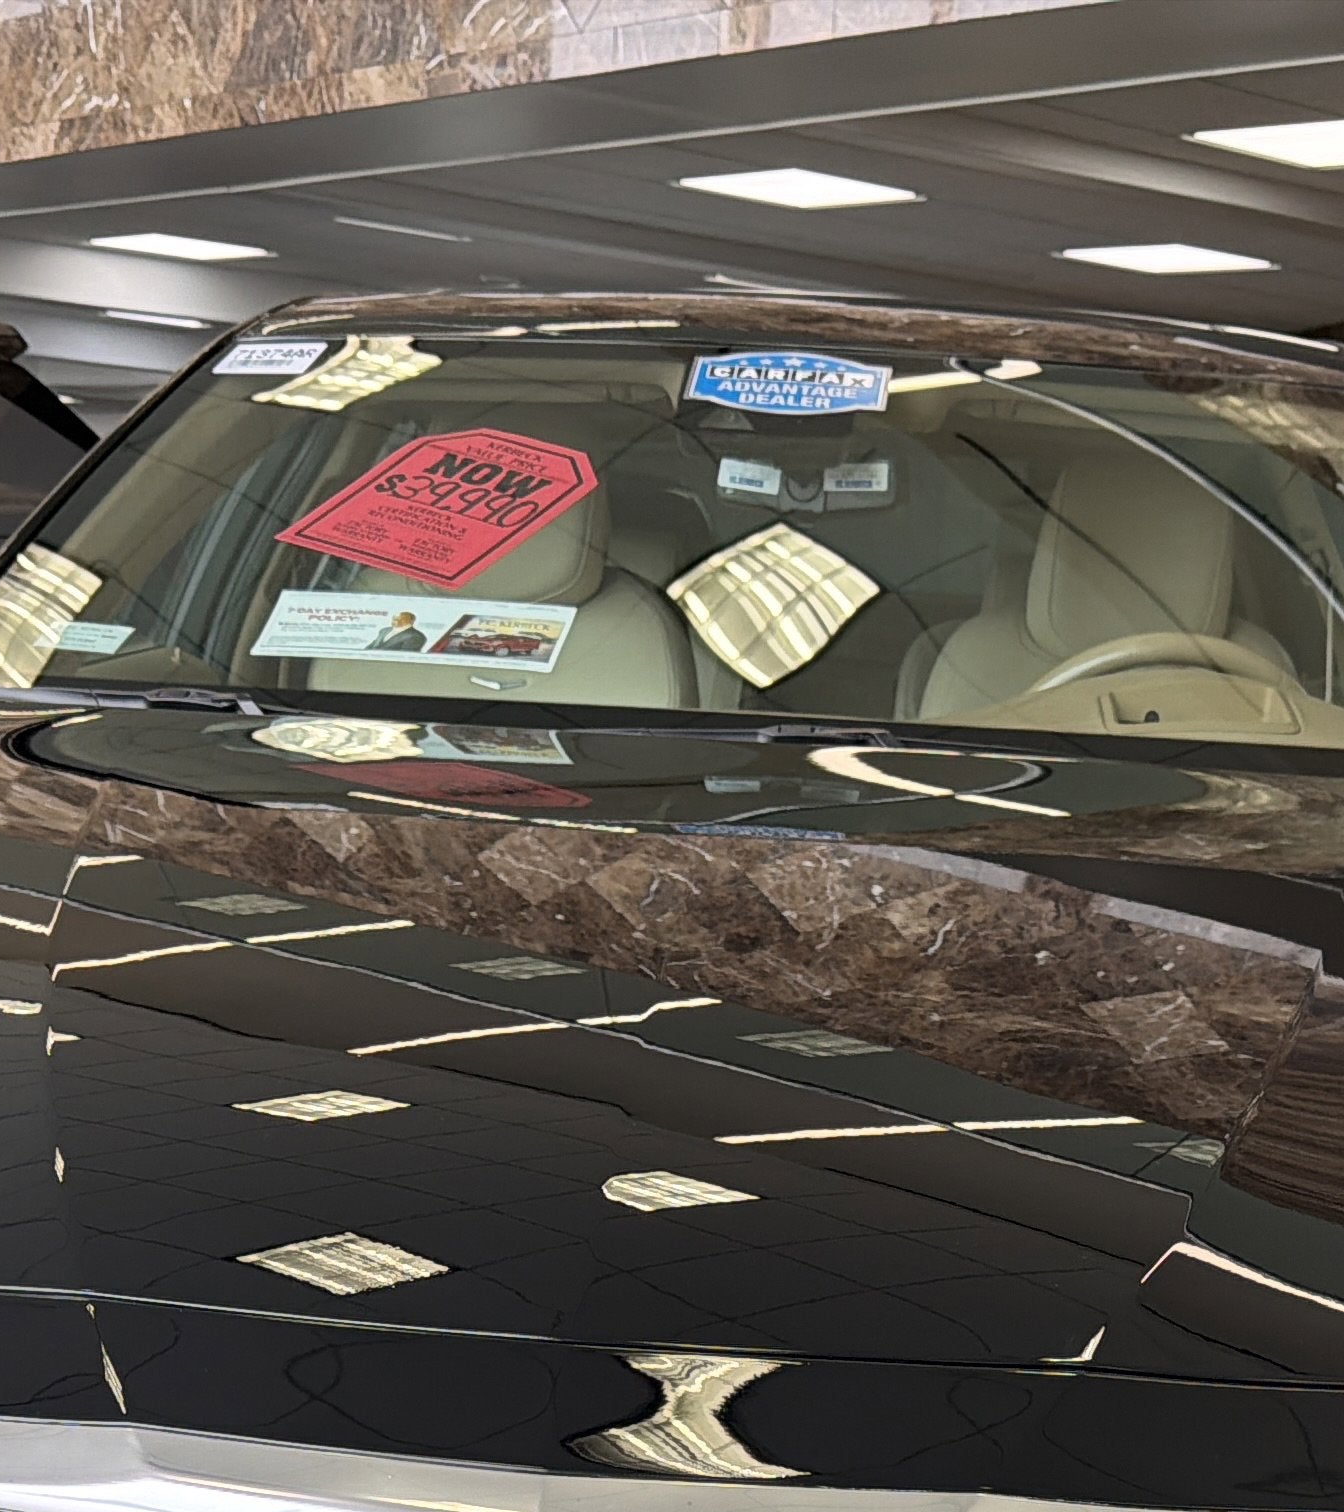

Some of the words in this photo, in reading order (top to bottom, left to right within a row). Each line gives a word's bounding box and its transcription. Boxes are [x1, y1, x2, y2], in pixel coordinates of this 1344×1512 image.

[710, 365, 874, 388] CARFAX
[716, 381, 857, 399] ADVANTAGE
[738, 392, 831, 409] DEALER
[422, 452, 553, 498] NOW
